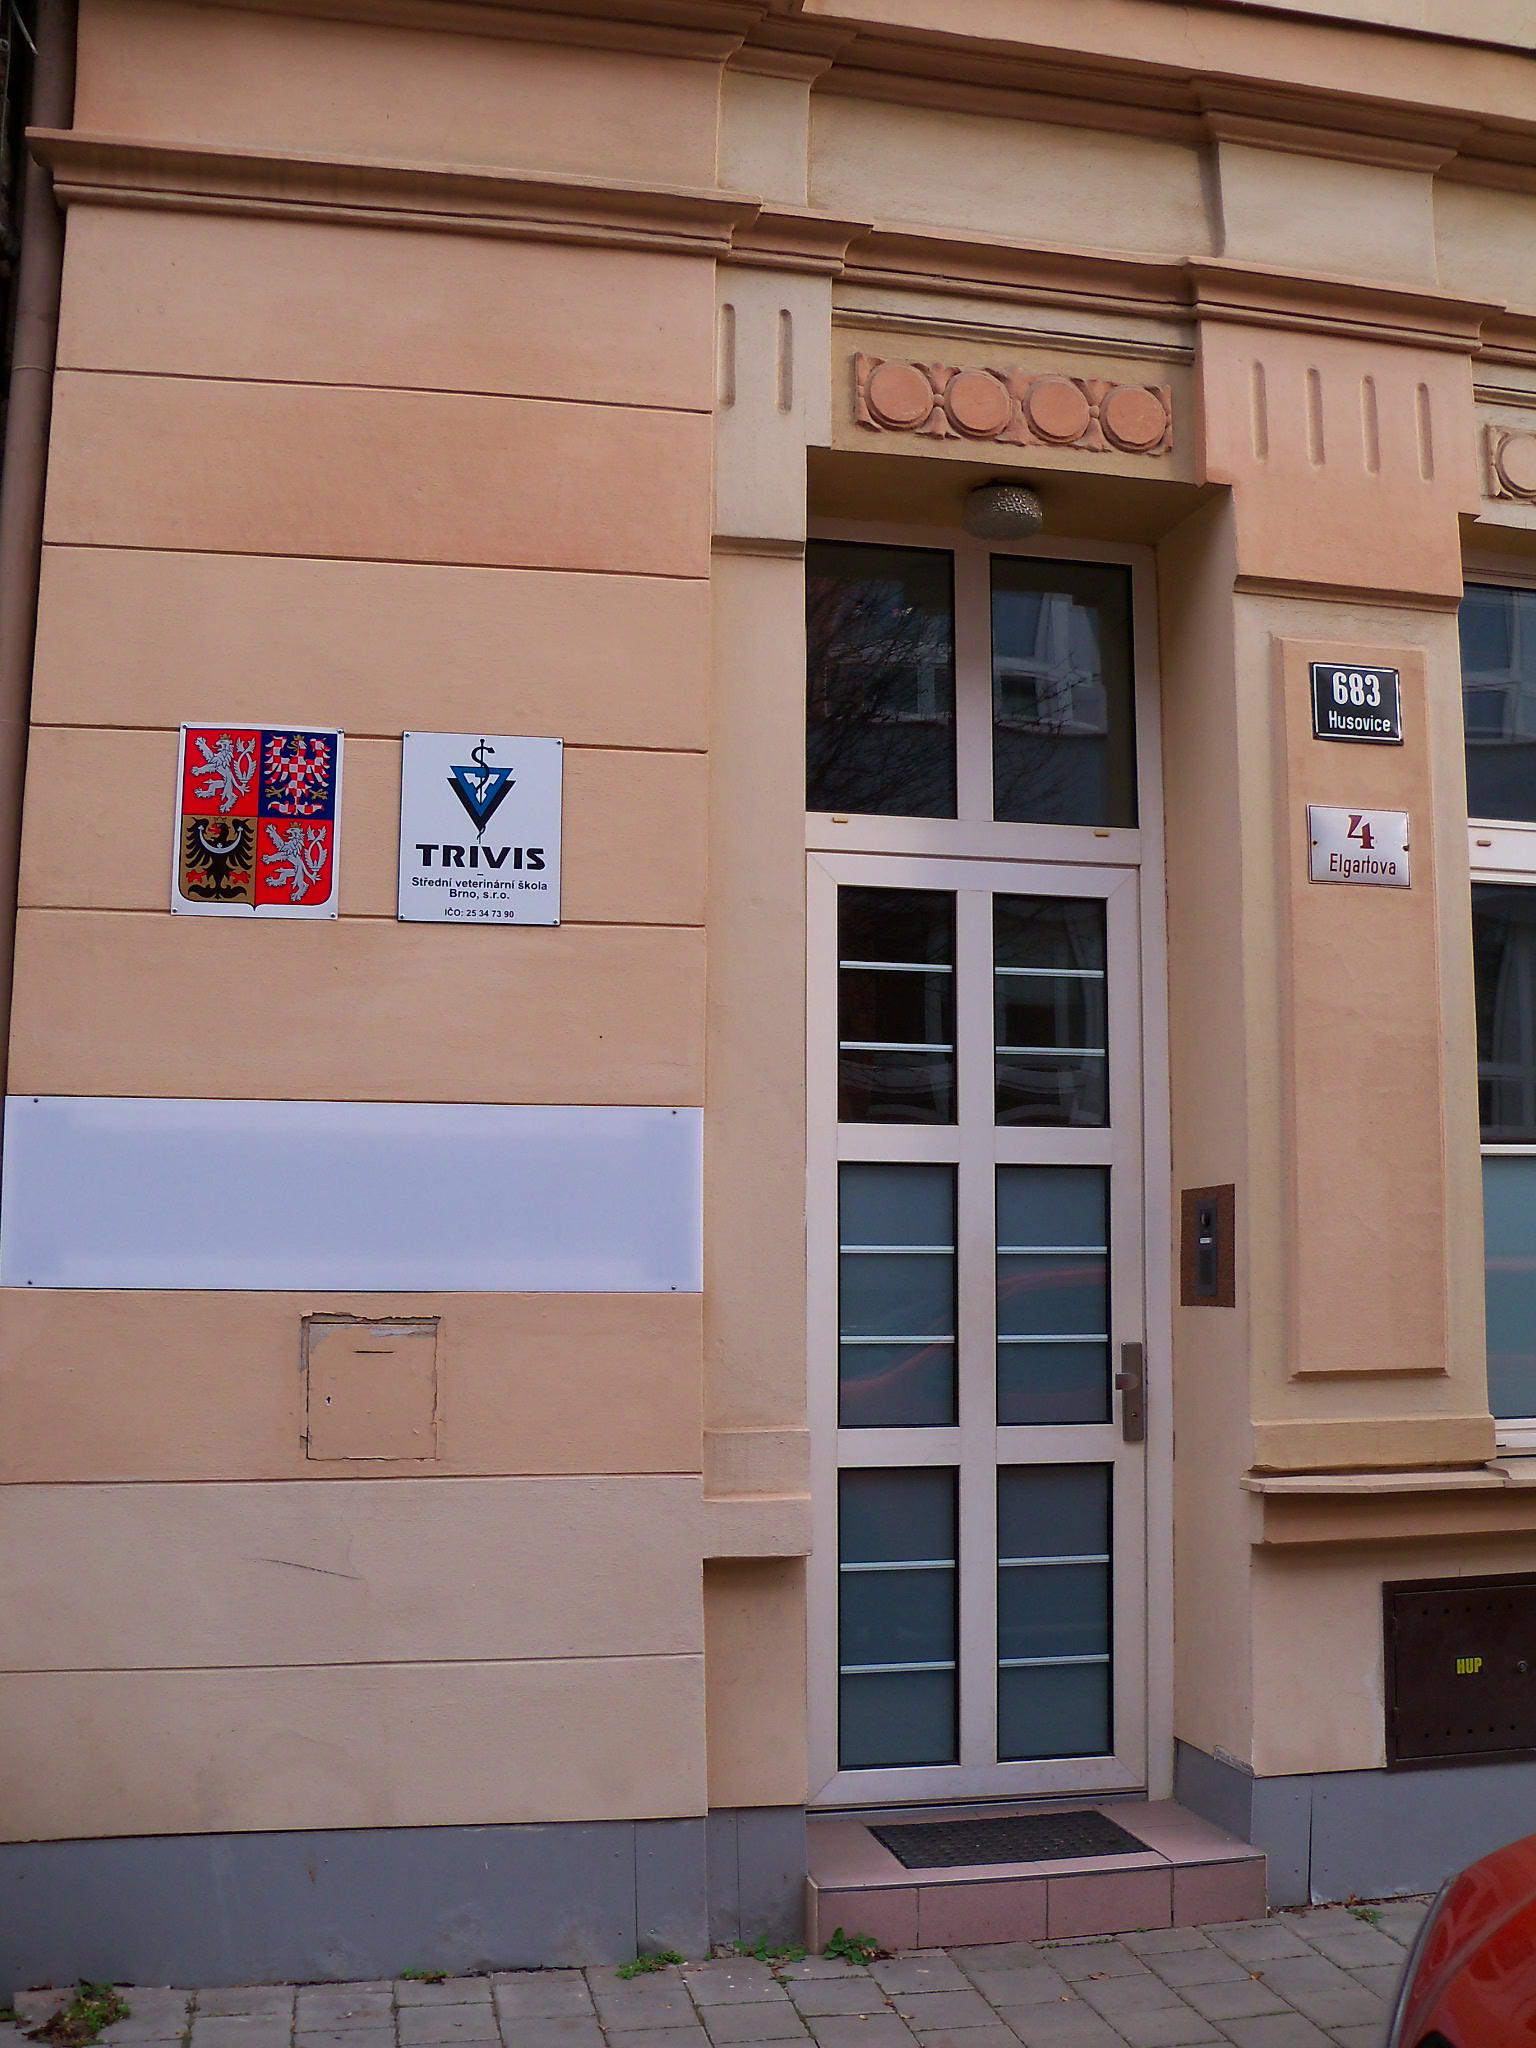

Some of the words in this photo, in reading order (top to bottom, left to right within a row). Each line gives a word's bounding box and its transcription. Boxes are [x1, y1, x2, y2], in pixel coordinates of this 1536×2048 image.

[1332, 671, 1381, 707] 683
[1328, 710, 1391, 732] Husovice
[1347, 814, 1375, 850] 4
[415, 843, 546, 871] TRIVIS
[1329, 853, 1396, 879] Elgartova
[411, 876, 453, 888] Střední
[455, 879, 515, 890] veterinární
[517, 880, 548, 891] škola
[449, 888, 480, 900] Brno,
[482, 891, 510, 900] s.r.o.
[444, 907, 464, 917] IČO:
[466, 909, 477, 917] 25
[478, 909, 489, 917] 34
[491, 910, 502, 918] 73
[504, 910, 515, 918] 90
[1456, 1657, 1482, 1675] HUP
